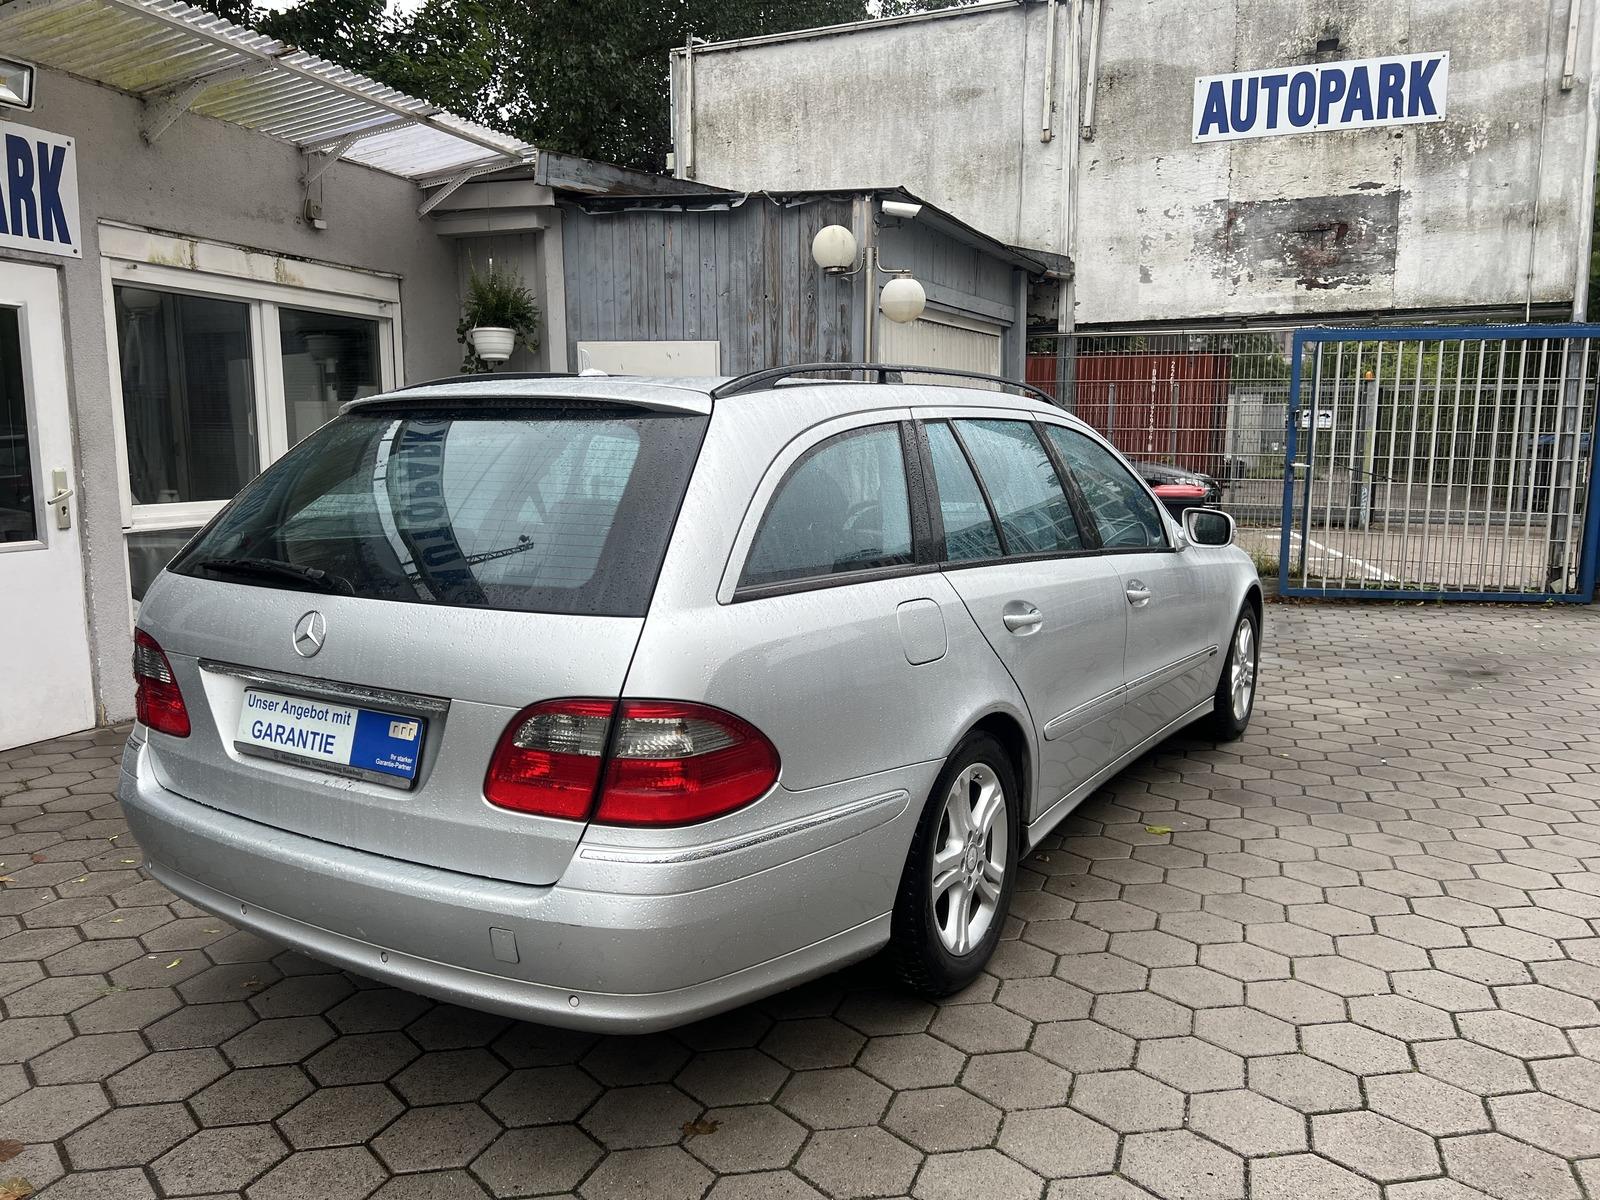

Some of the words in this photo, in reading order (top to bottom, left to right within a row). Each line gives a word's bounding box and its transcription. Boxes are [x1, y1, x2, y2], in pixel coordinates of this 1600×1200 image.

[1198, 59, 1441, 135] AUTOPARK
[248, 694, 279, 711] Unser
[281, 700, 329, 721] Angebot
[332, 711, 351, 725] mit
[251, 720, 336, 754] GARANTIE
